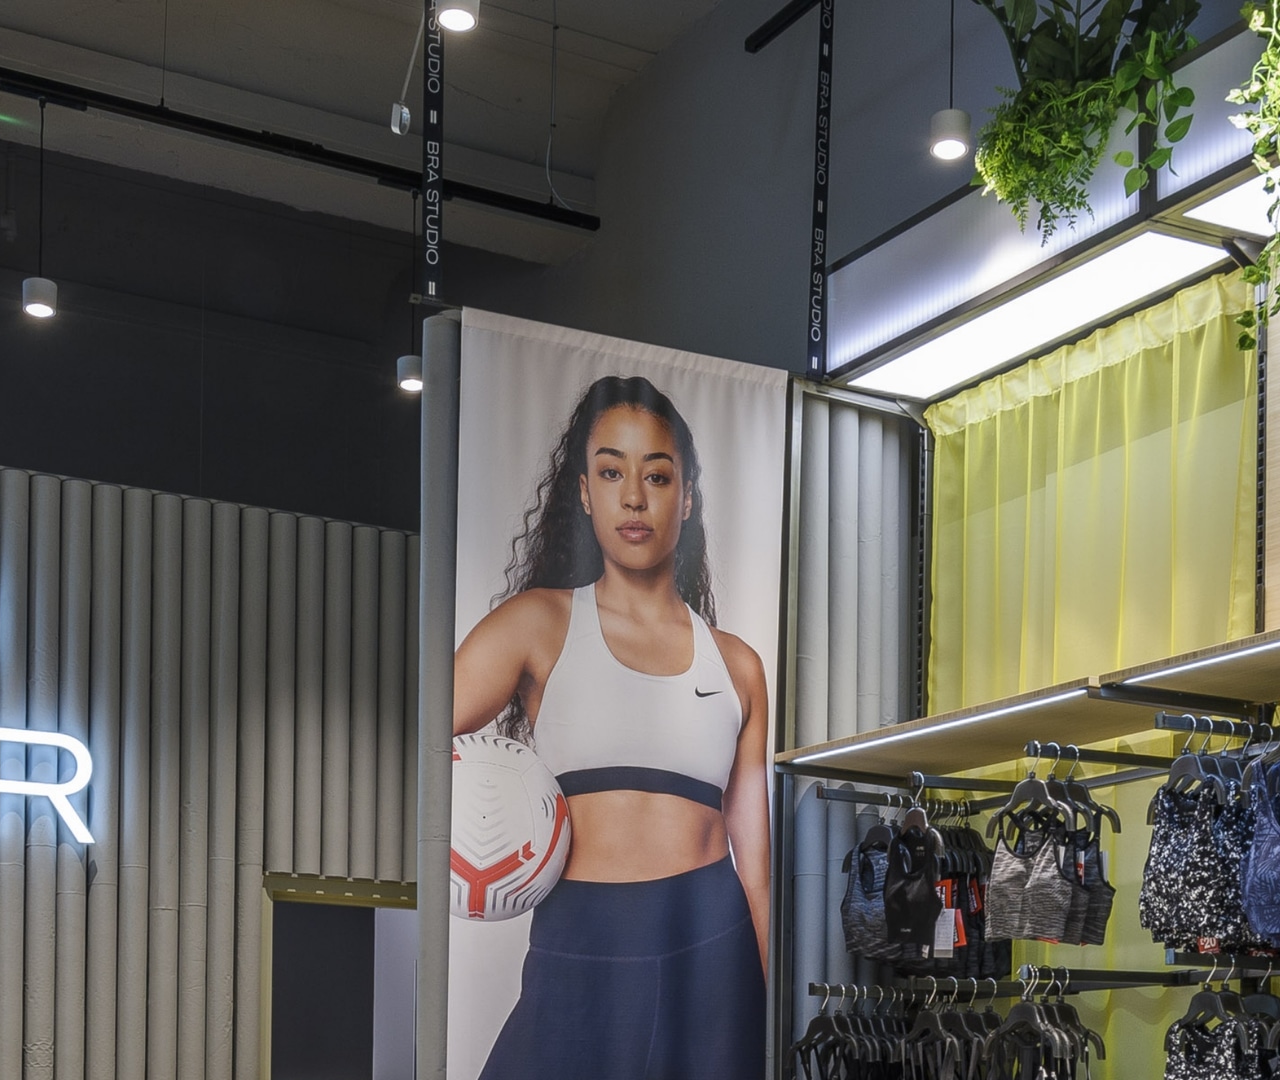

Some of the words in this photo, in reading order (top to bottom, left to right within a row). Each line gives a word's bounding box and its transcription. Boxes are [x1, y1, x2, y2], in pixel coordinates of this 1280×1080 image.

[427, 17, 440, 94] STUDIO
[820, 70, 829, 109] BRA
[427, 140, 439, 182] BRA
[816, 114, 828, 185] STUDIO
[426, 188, 439, 265] STUDIO
[813, 228, 824, 266] BRA
[810, 271, 822, 342] STUDIO
[1200, 937, 1217, 949] £20
